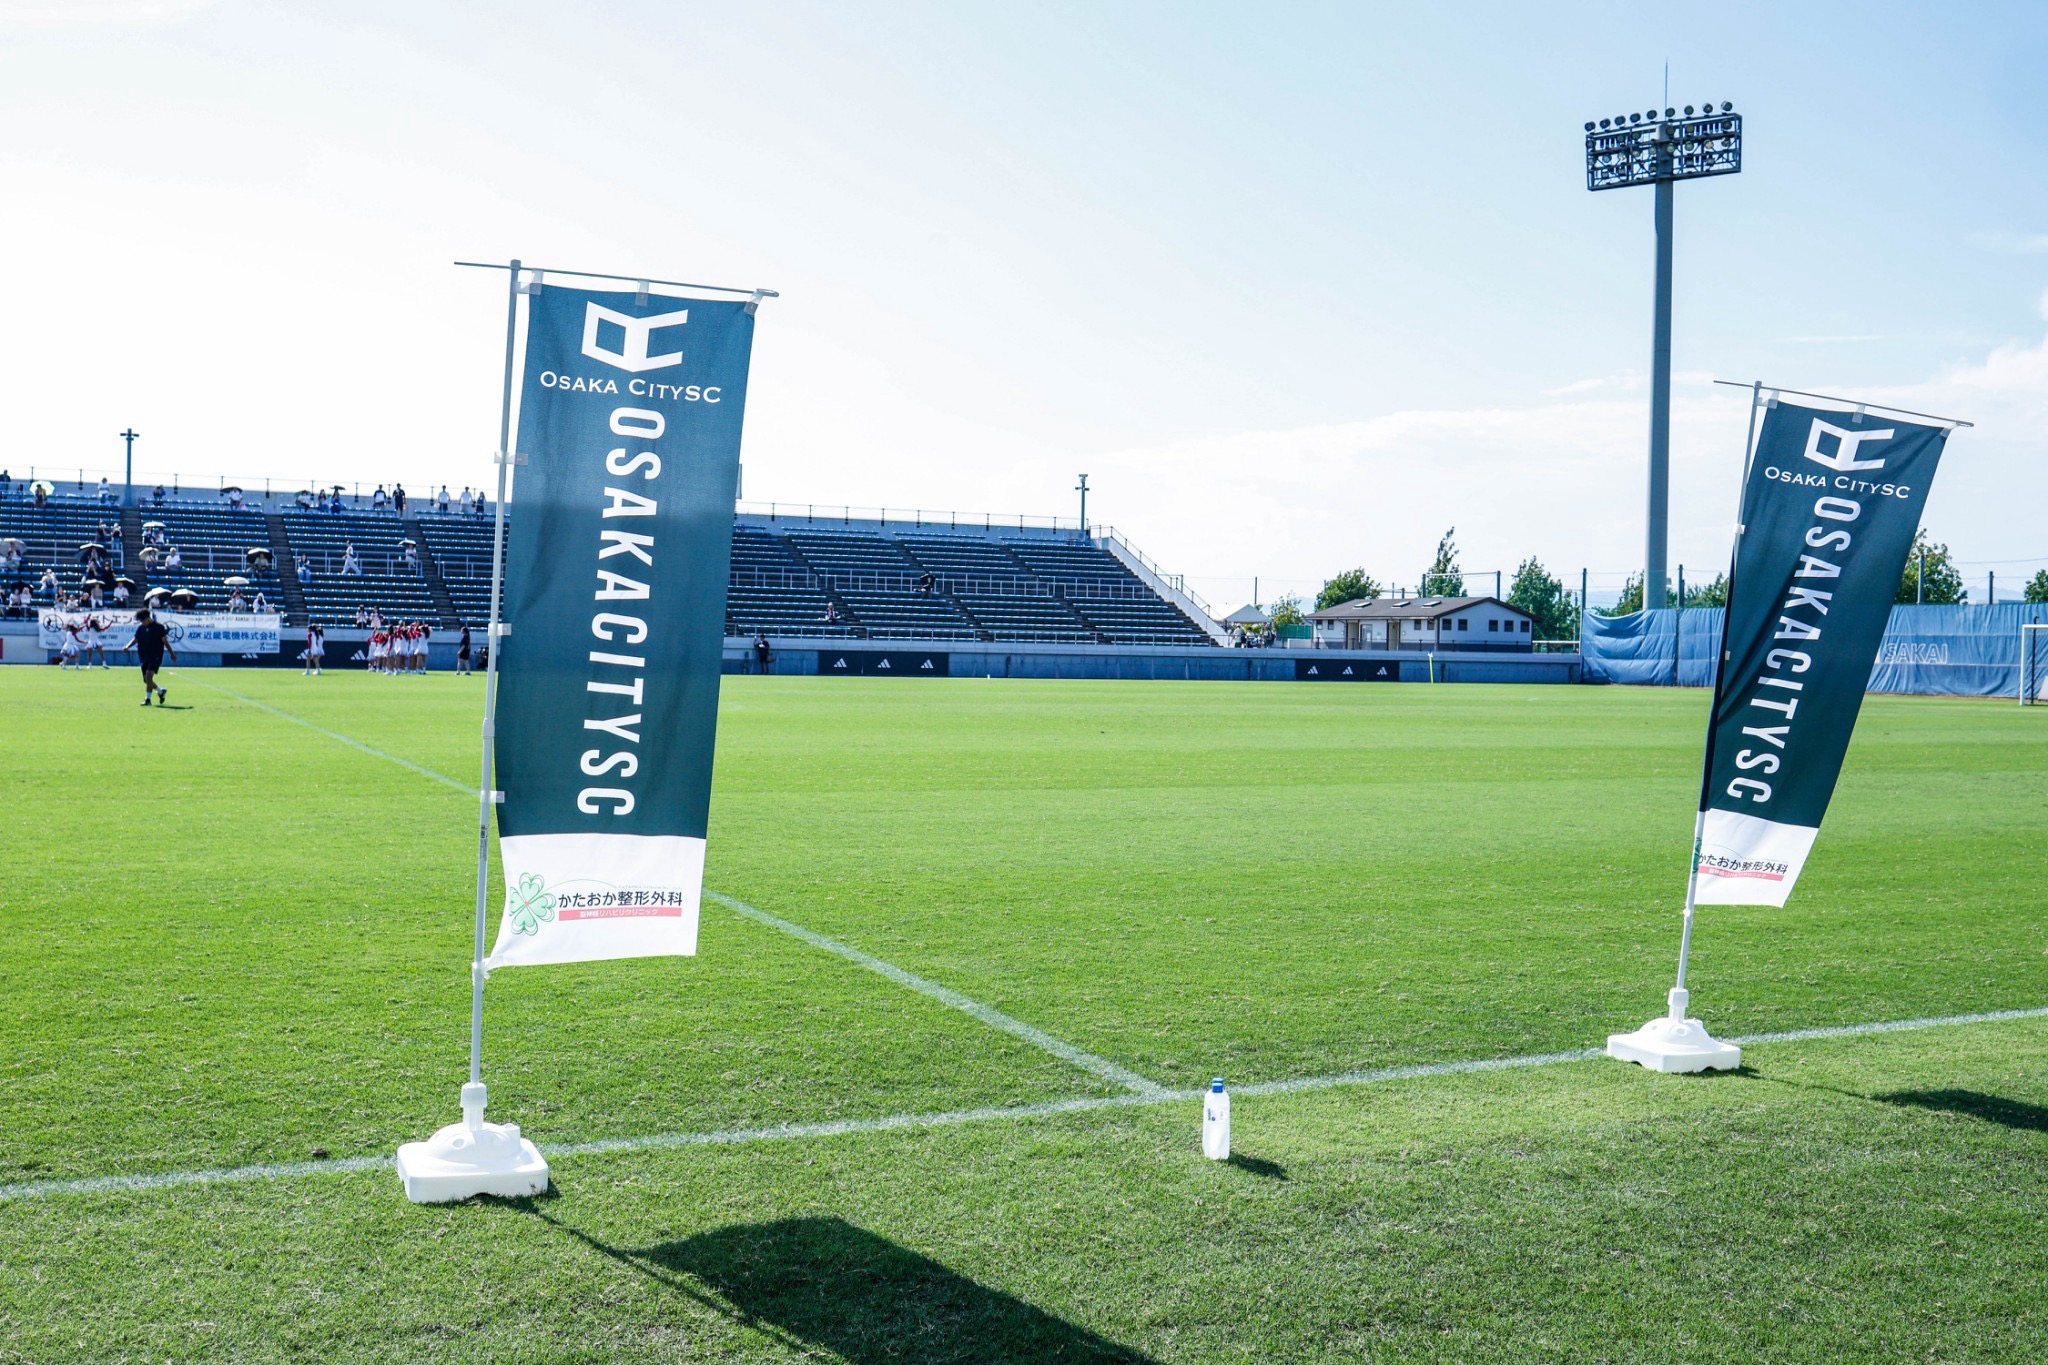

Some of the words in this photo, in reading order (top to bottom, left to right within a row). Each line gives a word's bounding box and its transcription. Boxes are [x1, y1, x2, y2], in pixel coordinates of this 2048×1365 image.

[540, 371, 618, 394] OSAKA
[628, 378, 721, 403] CITYSC
[1764, 466, 1827, 487] OSAKA
[1834, 476, 1911, 499] CITYSC
[577, 407, 665, 815] OSAKACITYSC
[1726, 496, 1861, 803] OSAKACITYSC
[1884, 643, 1948, 664] SAKAI
[558, 890, 683, 908] かたおか整形外科
